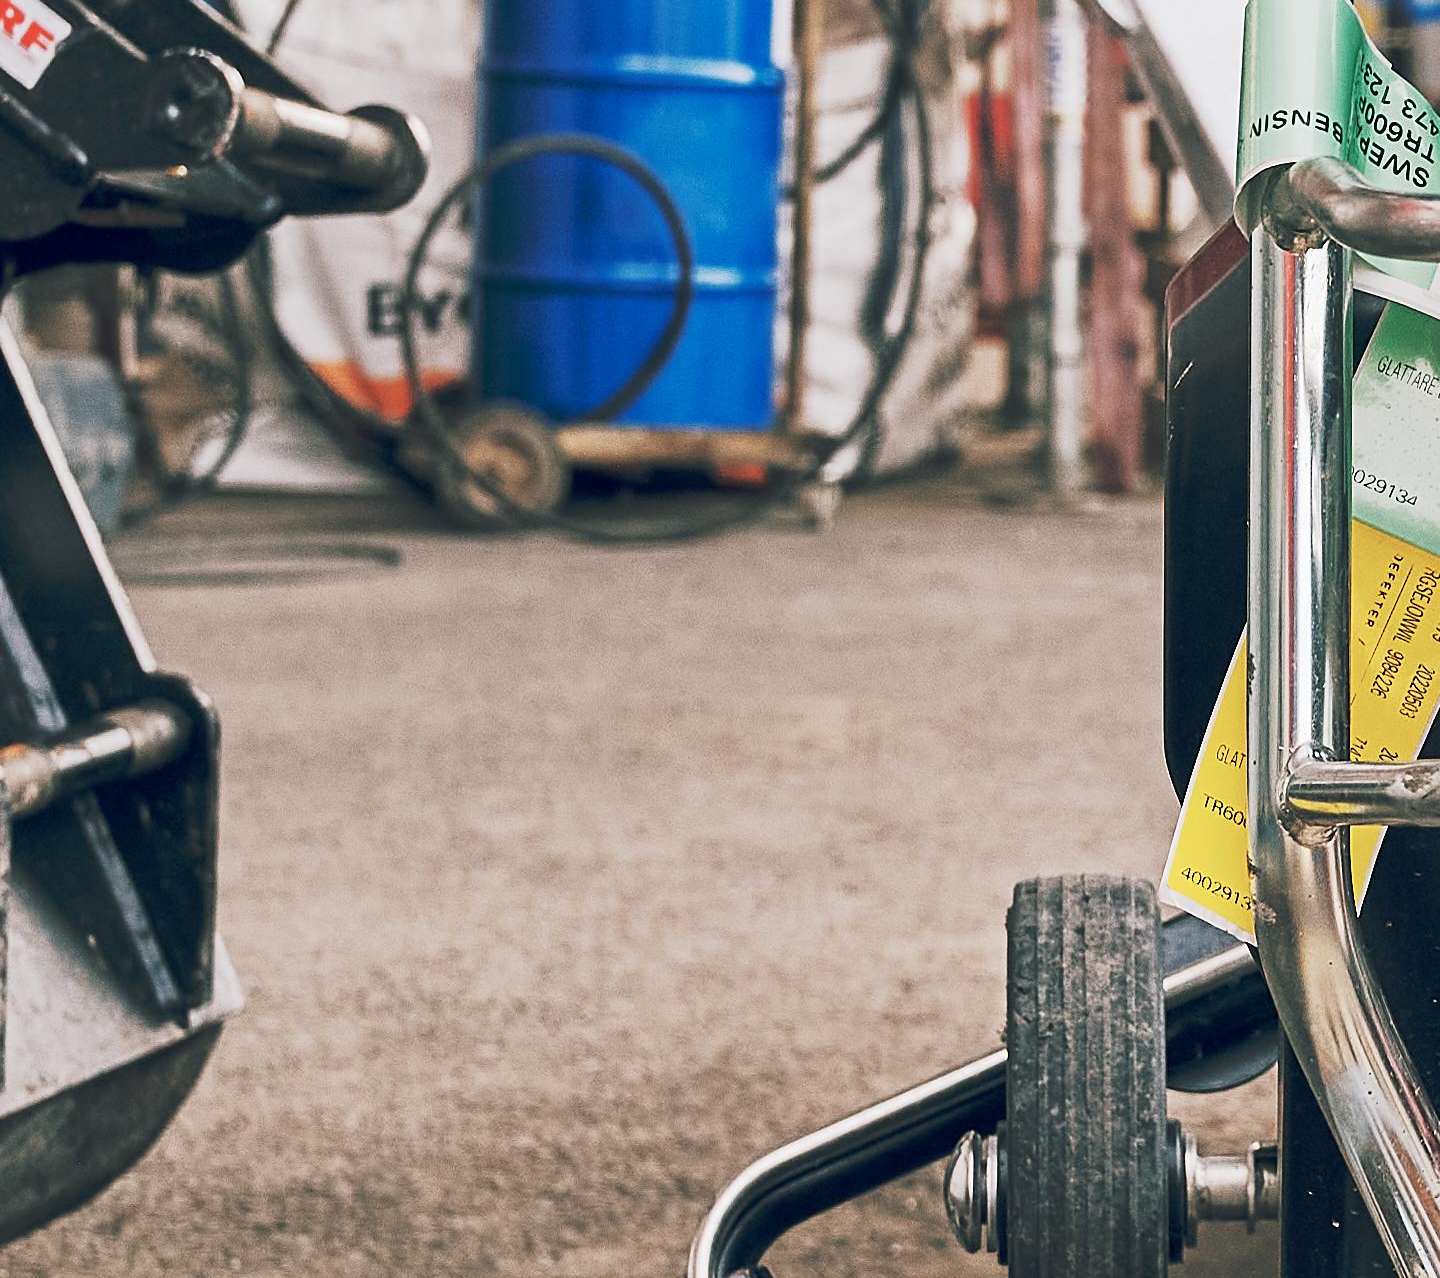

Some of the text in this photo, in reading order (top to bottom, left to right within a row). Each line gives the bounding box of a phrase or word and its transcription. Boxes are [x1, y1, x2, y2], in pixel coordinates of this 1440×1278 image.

[1250, 109, 1344, 146] BENSIN
[1401, 98, 1440, 135] 473
[1377, 355, 1439, 396] GLATTARE
[1352, 465, 1418, 507] 029134
[1400, 663, 1436, 719] 20220503
[1216, 744, 1247, 770] GLAT
[1203, 793, 1247, 828] TR60
[1181, 866, 1253, 911] 4002913
